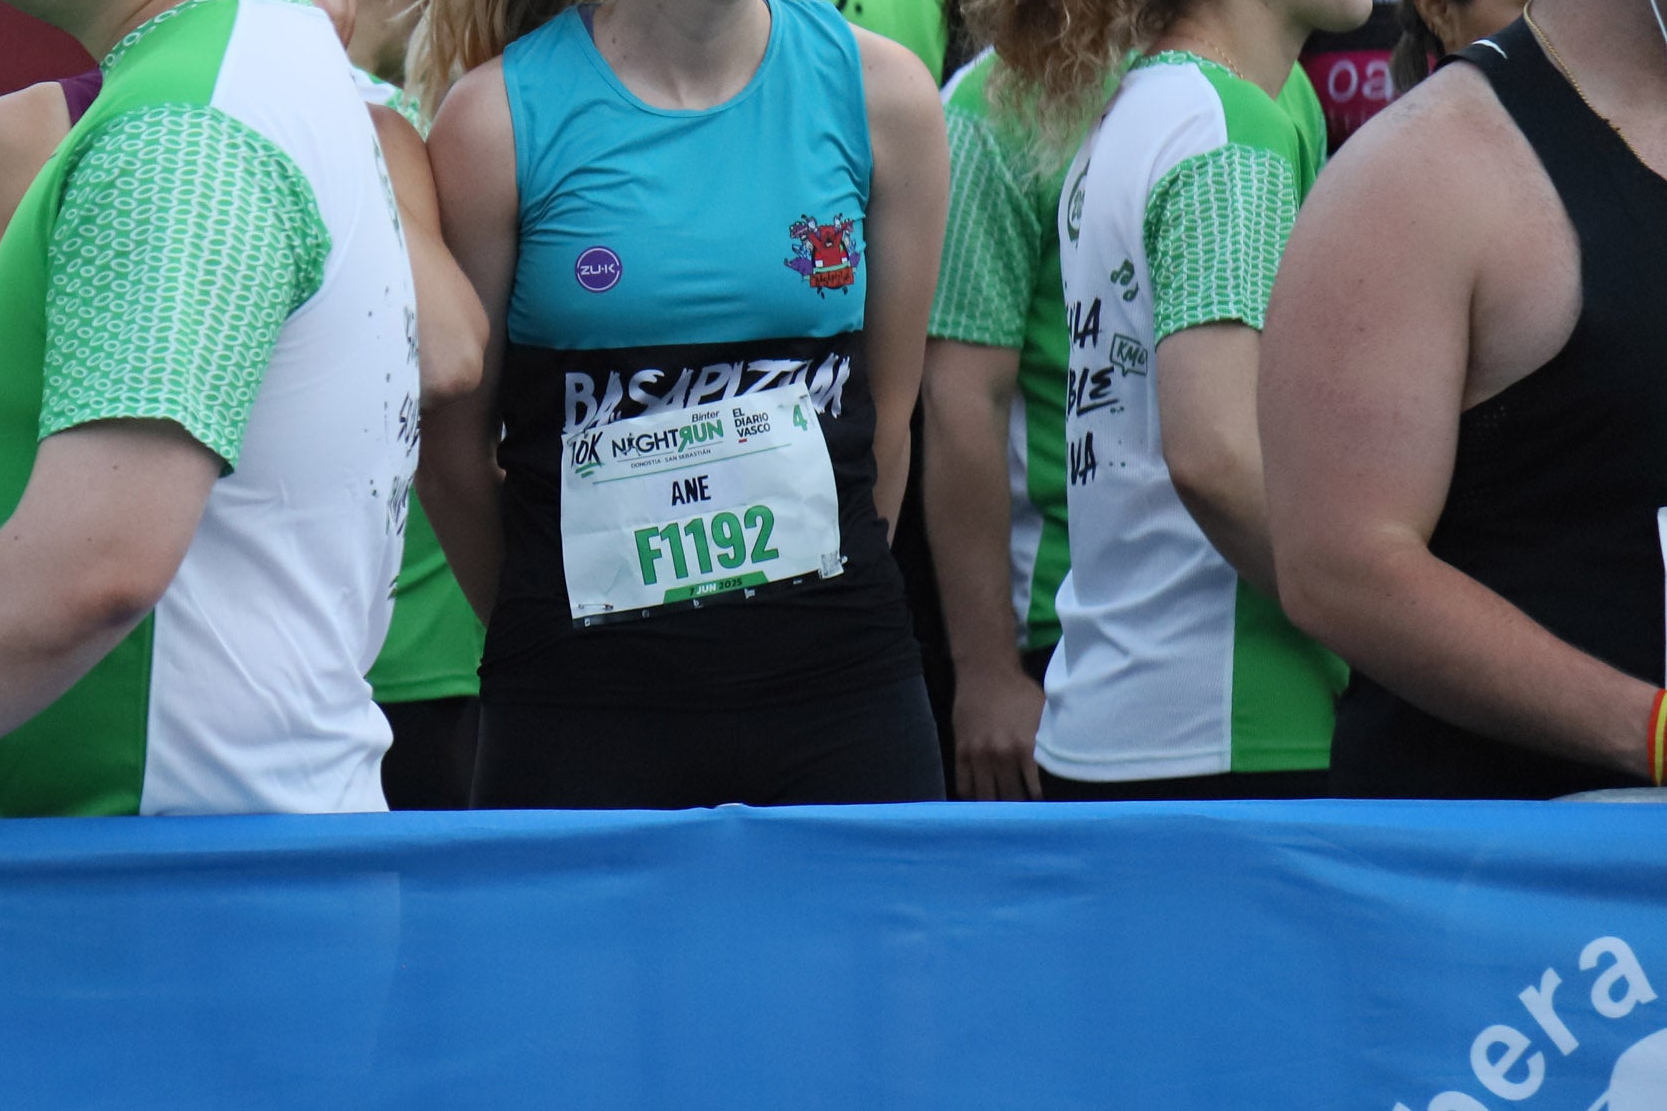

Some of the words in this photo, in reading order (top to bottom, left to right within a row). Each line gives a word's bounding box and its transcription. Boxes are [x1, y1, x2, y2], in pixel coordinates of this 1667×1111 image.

[691, 410, 721, 423] Binter
[732, 408, 745, 418] EL
[734, 412, 769, 428] DIARIO
[792, 404, 808, 432] 4
[736, 423, 771, 438] VASCO
[570, 431, 603, 467] 10K
[630, 458, 662, 469] DONOSTIA
[664, 455, 678, 464] SAN
[671, 475, 711, 506] ANE
[634, 504, 780, 585] F1192
[697, 583, 716, 595] JUN
[719, 578, 743, 590] 2025
